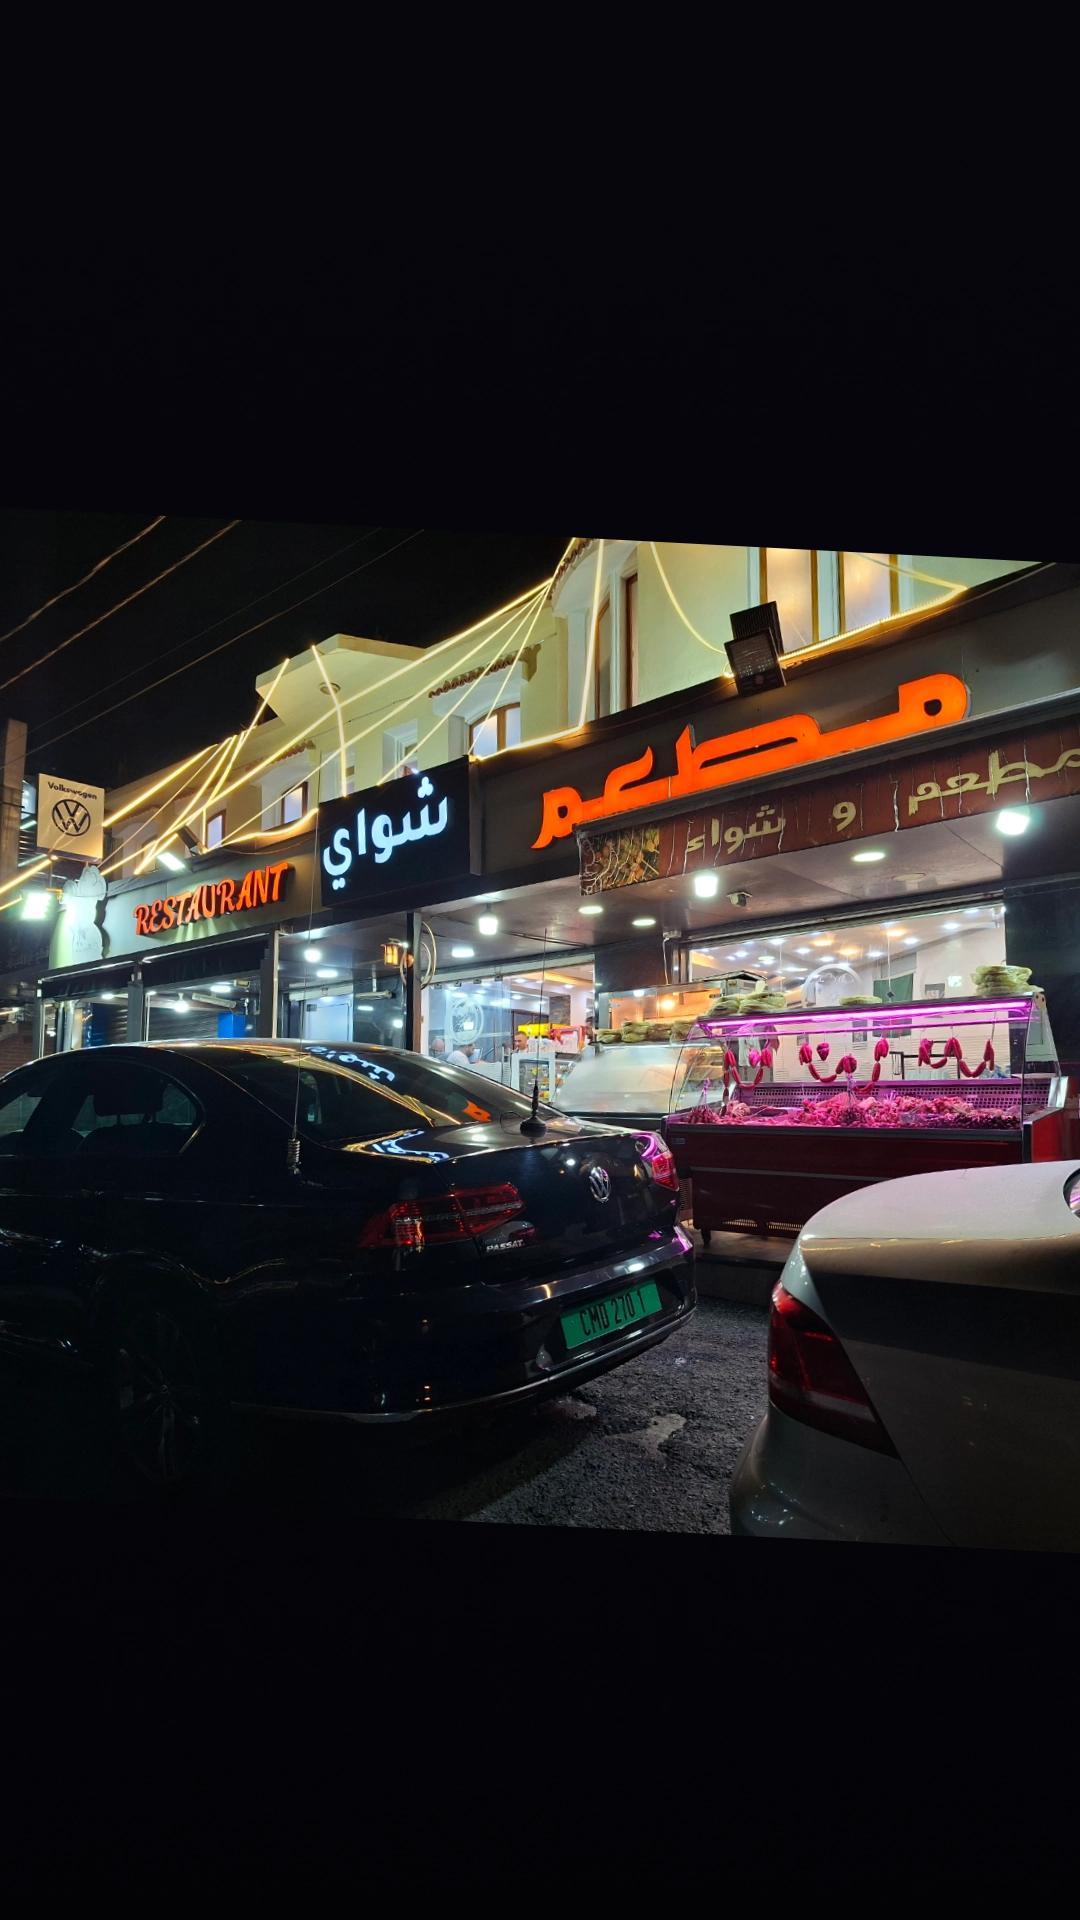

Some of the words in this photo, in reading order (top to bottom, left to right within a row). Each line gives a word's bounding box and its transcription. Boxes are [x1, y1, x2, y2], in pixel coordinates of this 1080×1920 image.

[531, 673, 968, 849] مطعم
[47, 781, 98, 800] Volkswagen
[322, 776, 448, 890] شواي
[686, 805, 786, 855] شواء
[832, 801, 856, 832] و
[133, 862, 289, 935] RESTAURANT
[486, 1239, 524, 1252] PASSAT
[579, 1303, 610, 1336] CMD
[611, 1292, 636, 1325] 270
